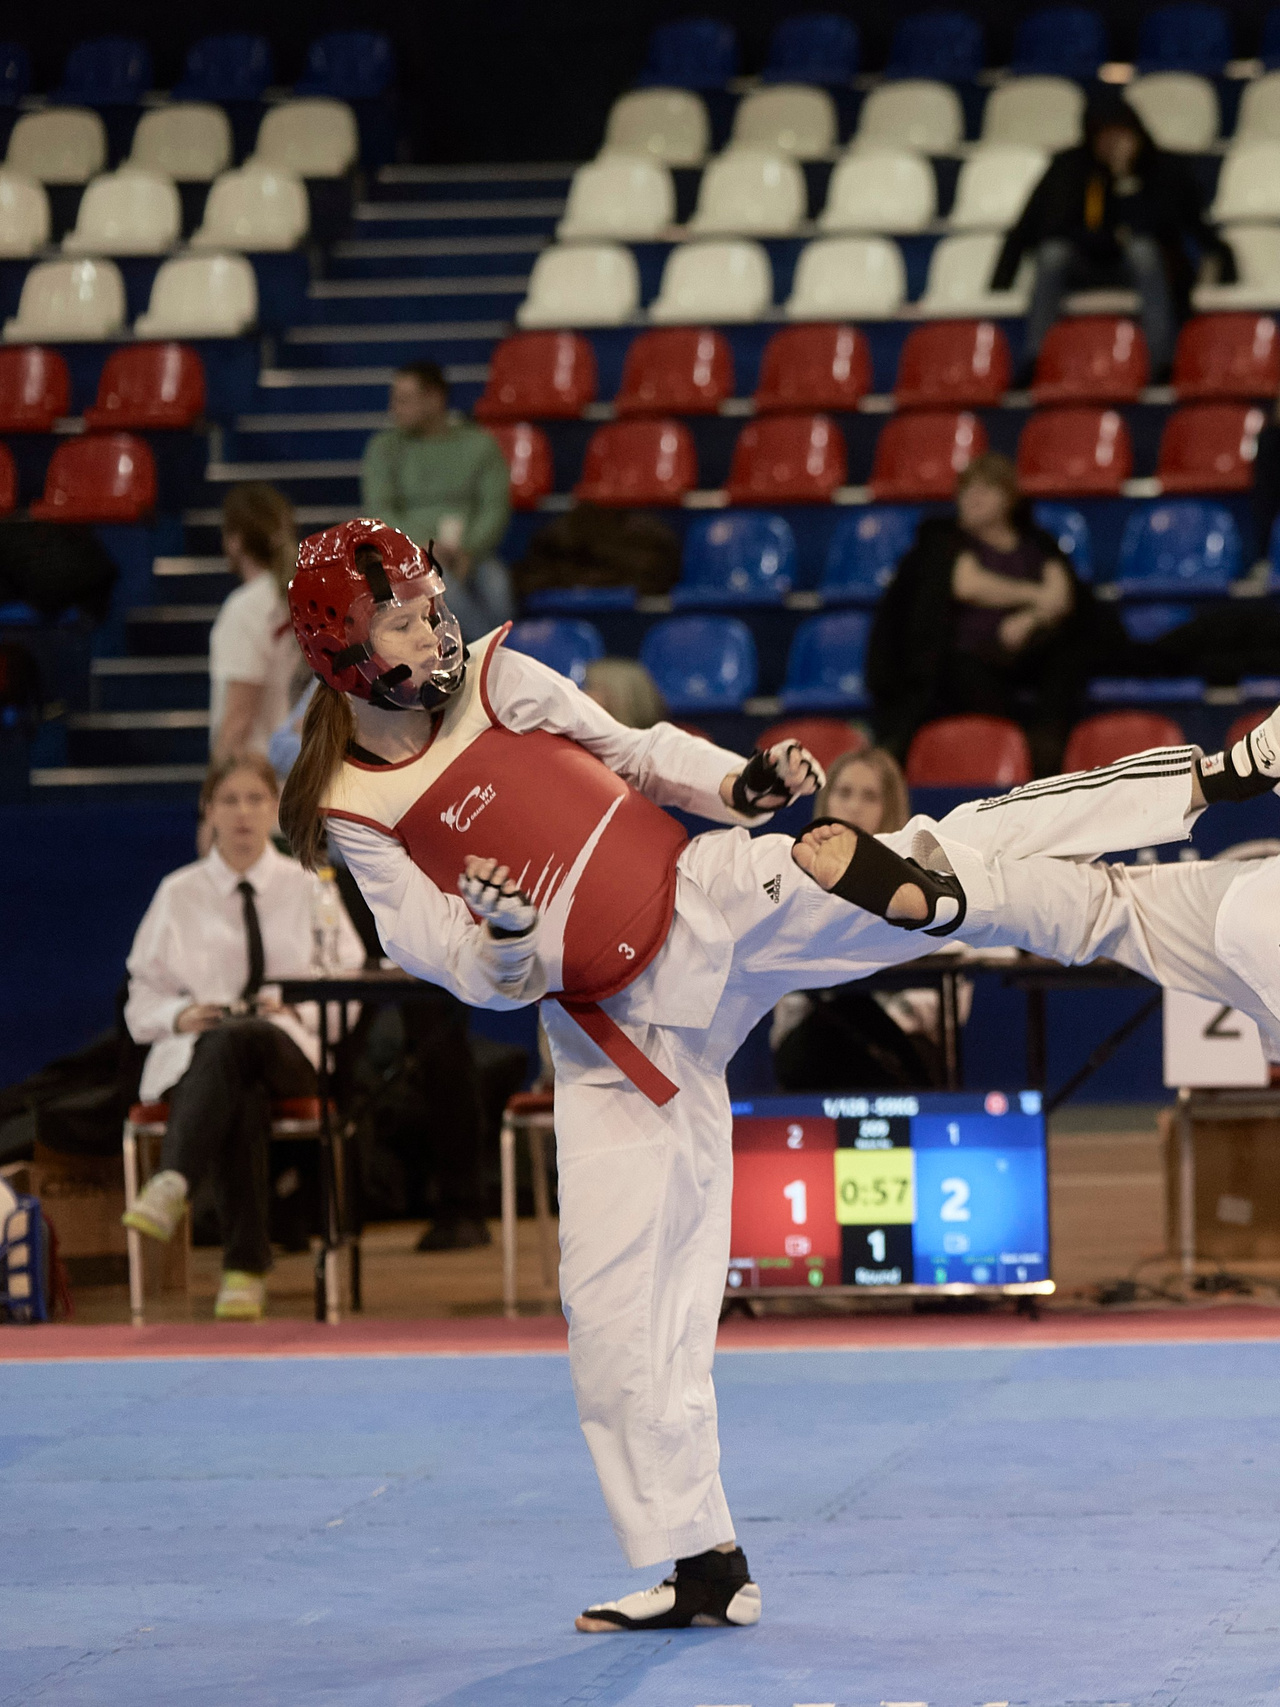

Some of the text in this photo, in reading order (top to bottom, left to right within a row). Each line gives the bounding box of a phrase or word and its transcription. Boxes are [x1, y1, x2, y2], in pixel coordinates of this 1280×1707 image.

[479, 783, 493, 801] WT
[618, 942, 635, 960] 3
[787, 1124, 803, 1149] 2
[947, 1122, 960, 1147] 1
[784, 1180, 807, 1224] 1
[840, 1178, 909, 1207] 0:57
[940, 1178, 971, 1222] 2
[867, 1229, 887, 1262] 1
